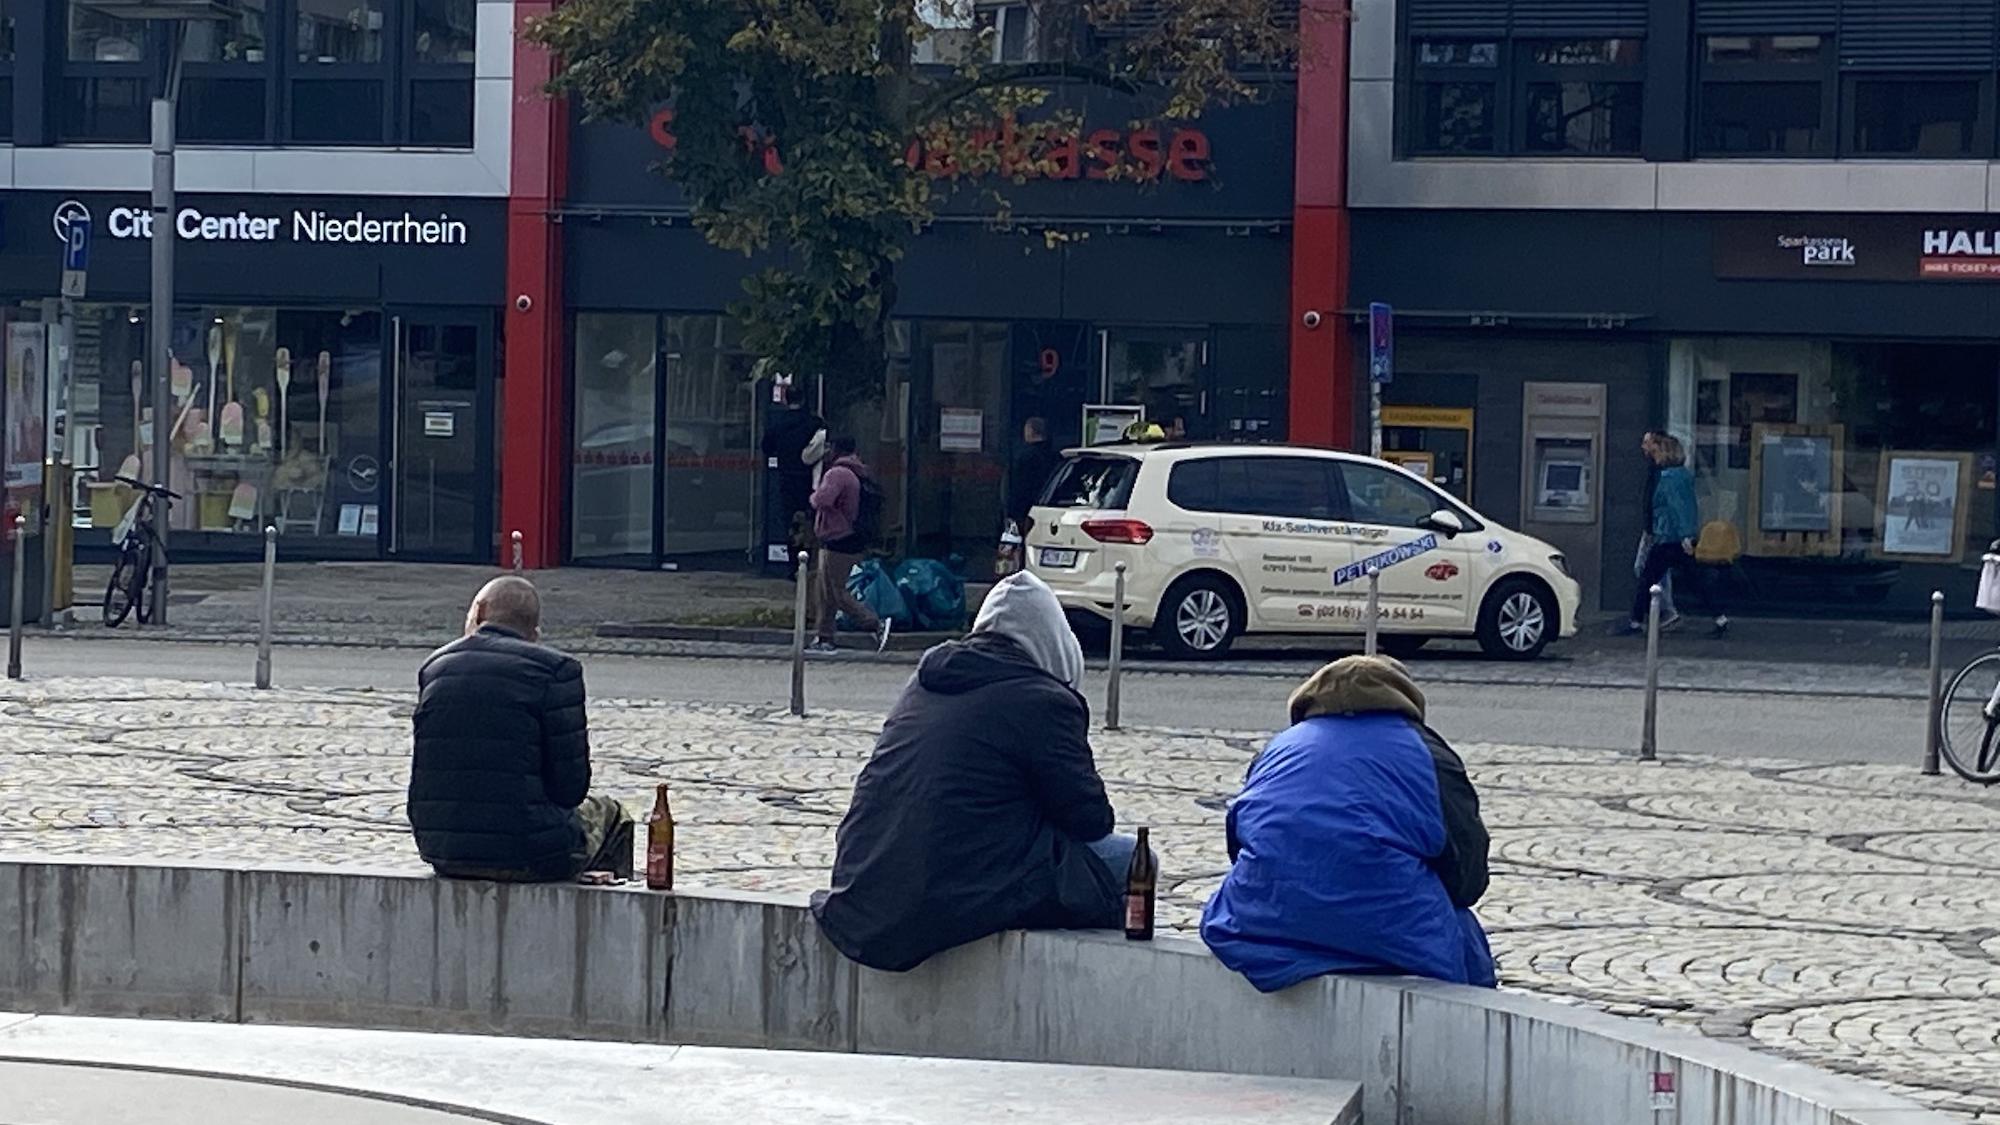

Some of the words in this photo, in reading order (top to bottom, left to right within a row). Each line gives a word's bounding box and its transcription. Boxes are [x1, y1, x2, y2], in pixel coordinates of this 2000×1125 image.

[108, 207, 153, 238] Cit
[176, 208, 280, 240] Center
[292, 210, 467, 244] Niederrhein
[70, 219, 85, 268] P
[1804, 238, 1855, 265] park
[1040, 349, 1059, 379] 9
[1336, 535, 1435, 582] PETRIKOWSKI
[1392, 607, 1406, 619] 54
[1410, 608, 1424, 620] 54
